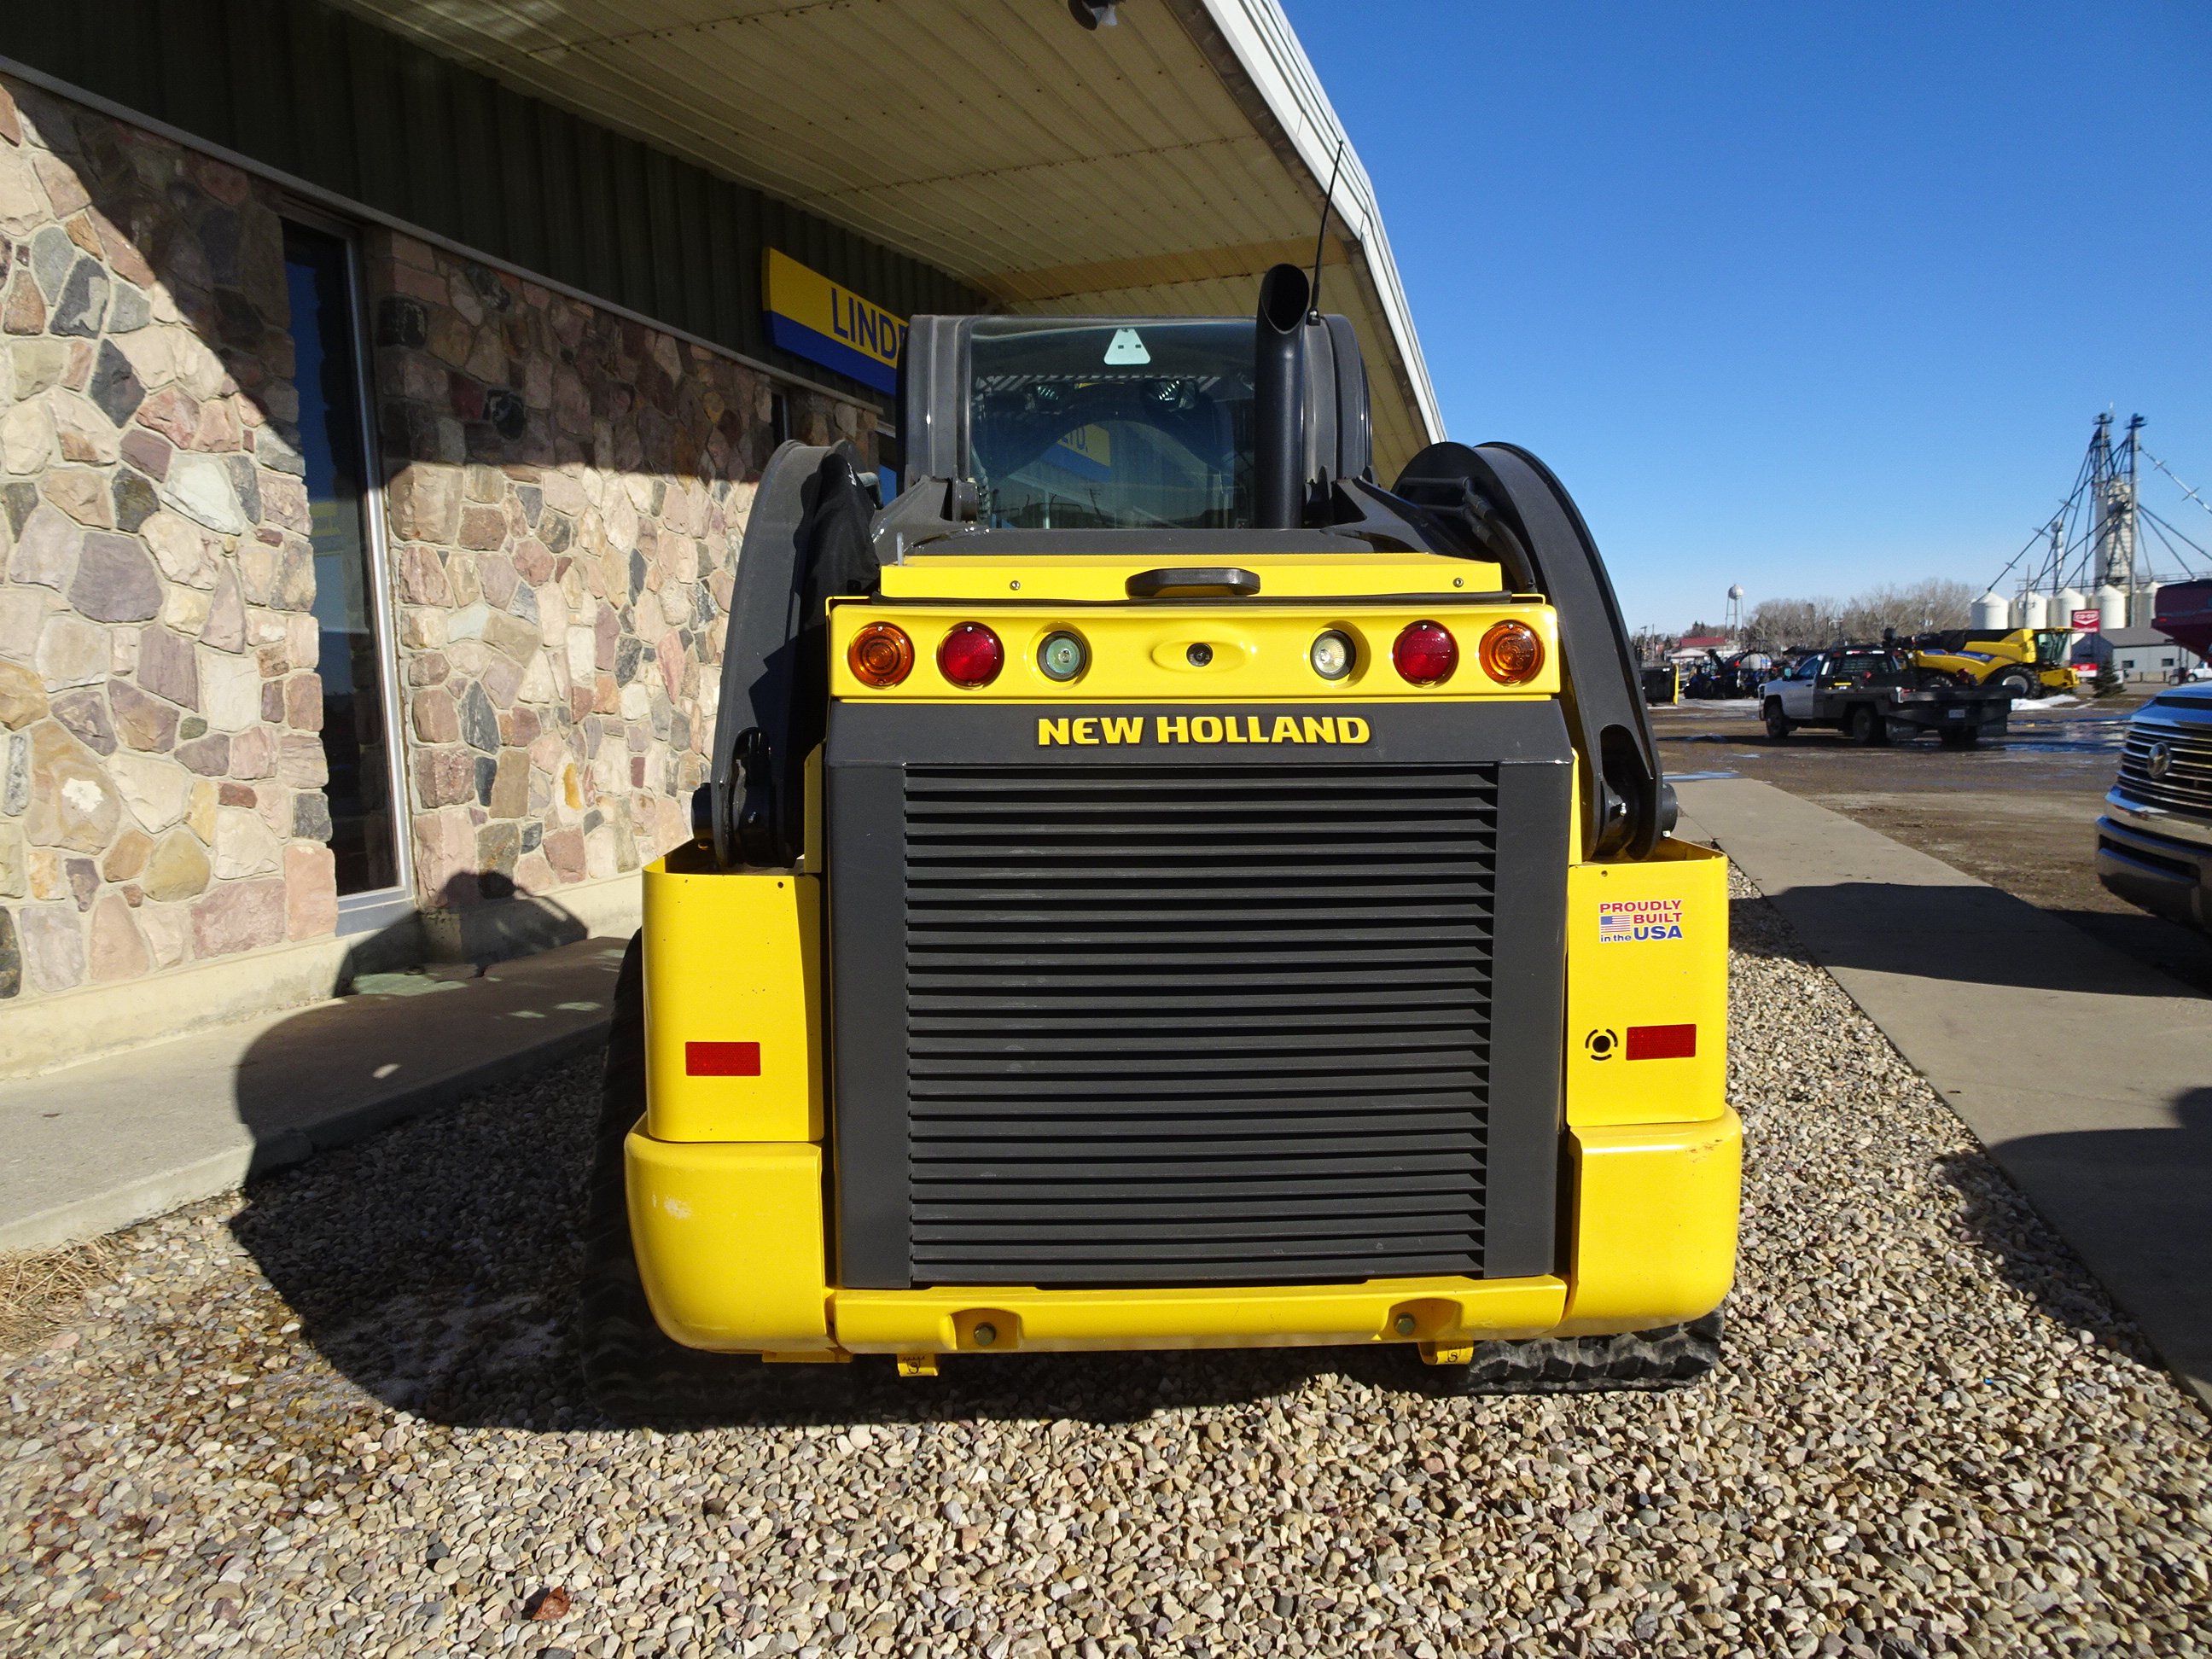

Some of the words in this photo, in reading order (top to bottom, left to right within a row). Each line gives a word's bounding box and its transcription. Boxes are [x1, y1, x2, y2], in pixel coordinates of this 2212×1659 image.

[1038, 717, 1144, 745] NEW
[1156, 716, 1371, 744] HOLLAND
[1600, 899, 1682, 913] PROUDLY
[1633, 912, 1682, 923] BUILT
[1633, 925, 1683, 940] USA
